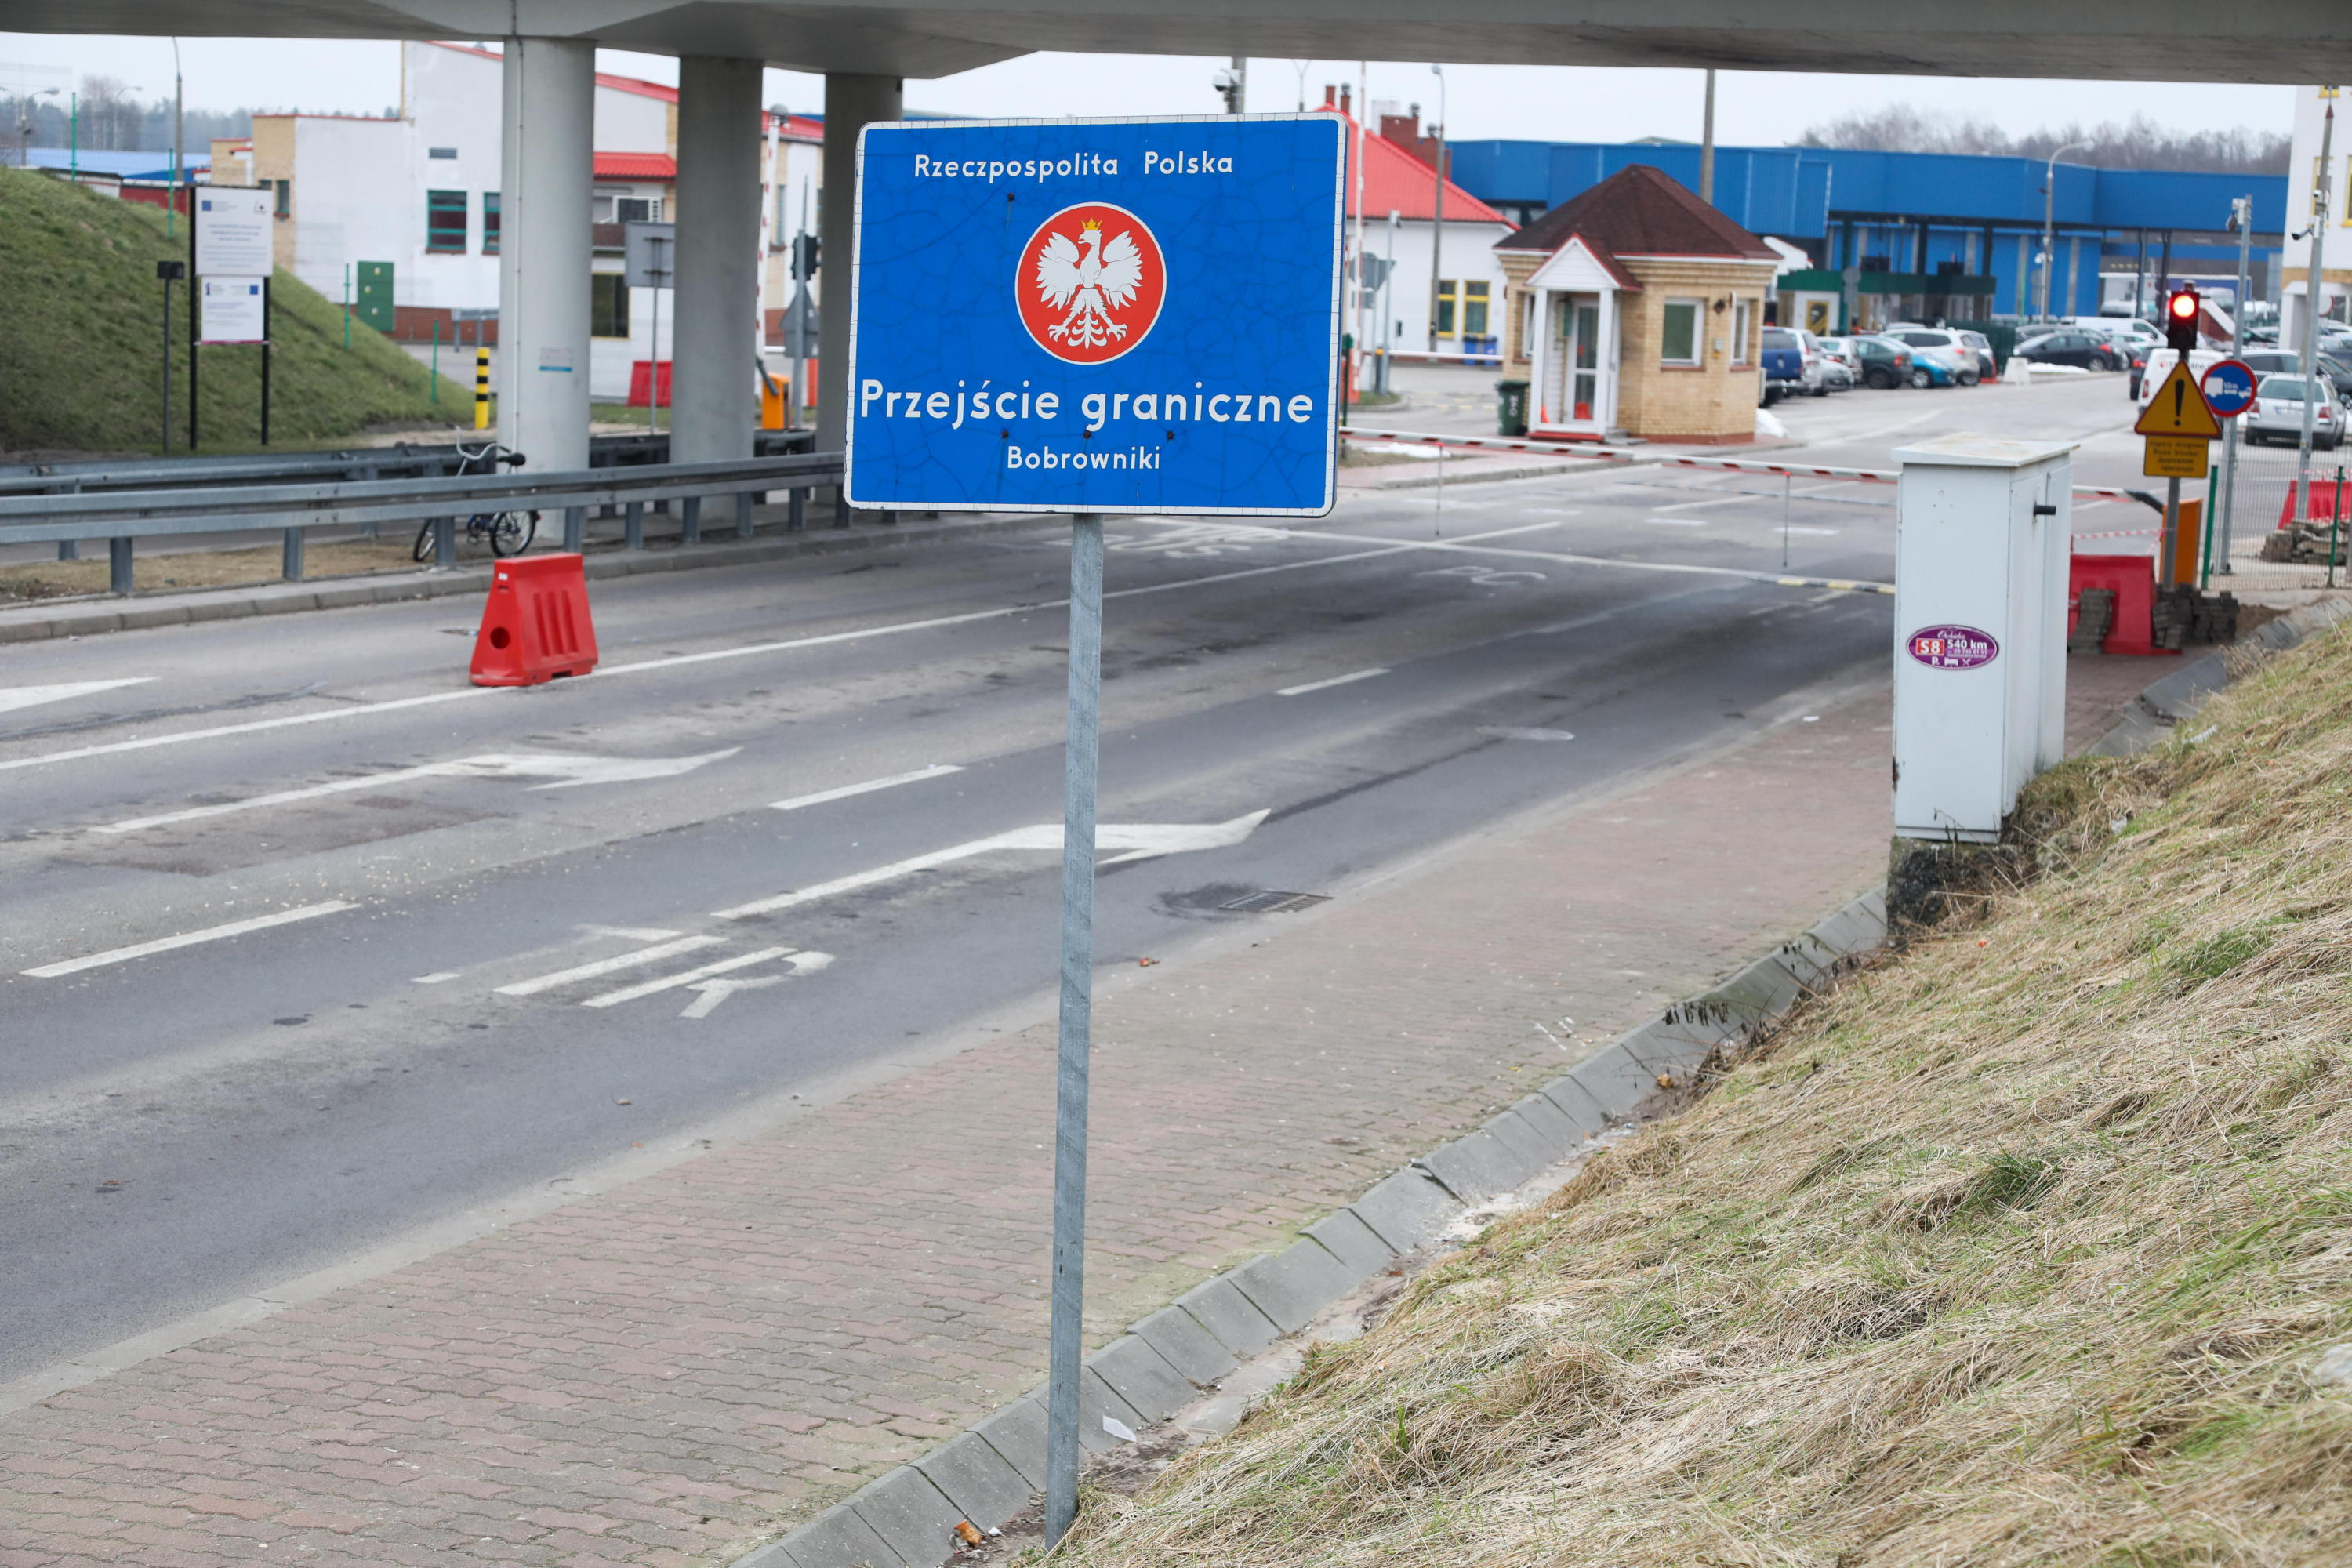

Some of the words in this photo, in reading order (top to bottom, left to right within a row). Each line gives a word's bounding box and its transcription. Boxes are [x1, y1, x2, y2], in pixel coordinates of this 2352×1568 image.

[914, 152, 1119, 183] Rzeczpospolita
[1144, 150, 1233, 174] Polska
[860, 379, 1060, 430] Przejście
[1080, 381, 1314, 432] graniczne
[1007, 445, 1160, 470] Bobrowniki
[1920, 639, 1940, 654] S8
[1947, 639, 1968, 649] 540
[1970, 640, 1987, 651] km
